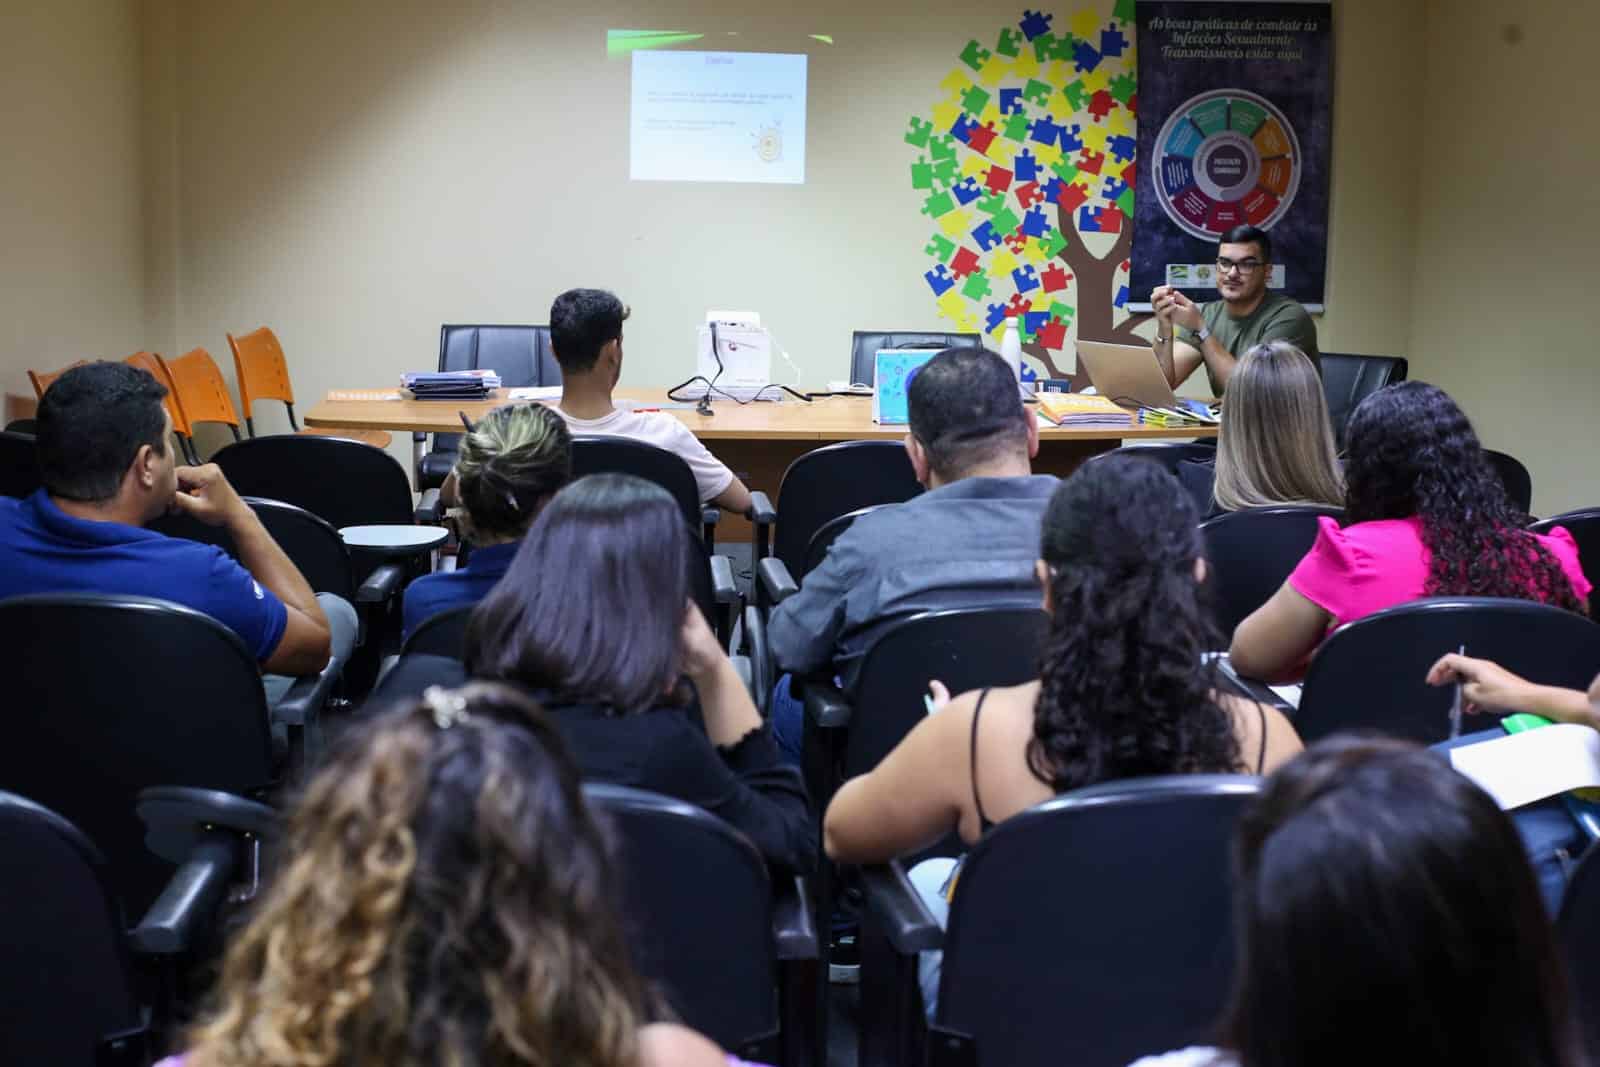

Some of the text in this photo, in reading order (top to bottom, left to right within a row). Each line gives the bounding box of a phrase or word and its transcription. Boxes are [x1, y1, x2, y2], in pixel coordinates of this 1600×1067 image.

[1240, 17, 1254, 30] de
[1256, 17, 1302, 31] combate
[1223, 32, 1296, 46] Sexualmente
